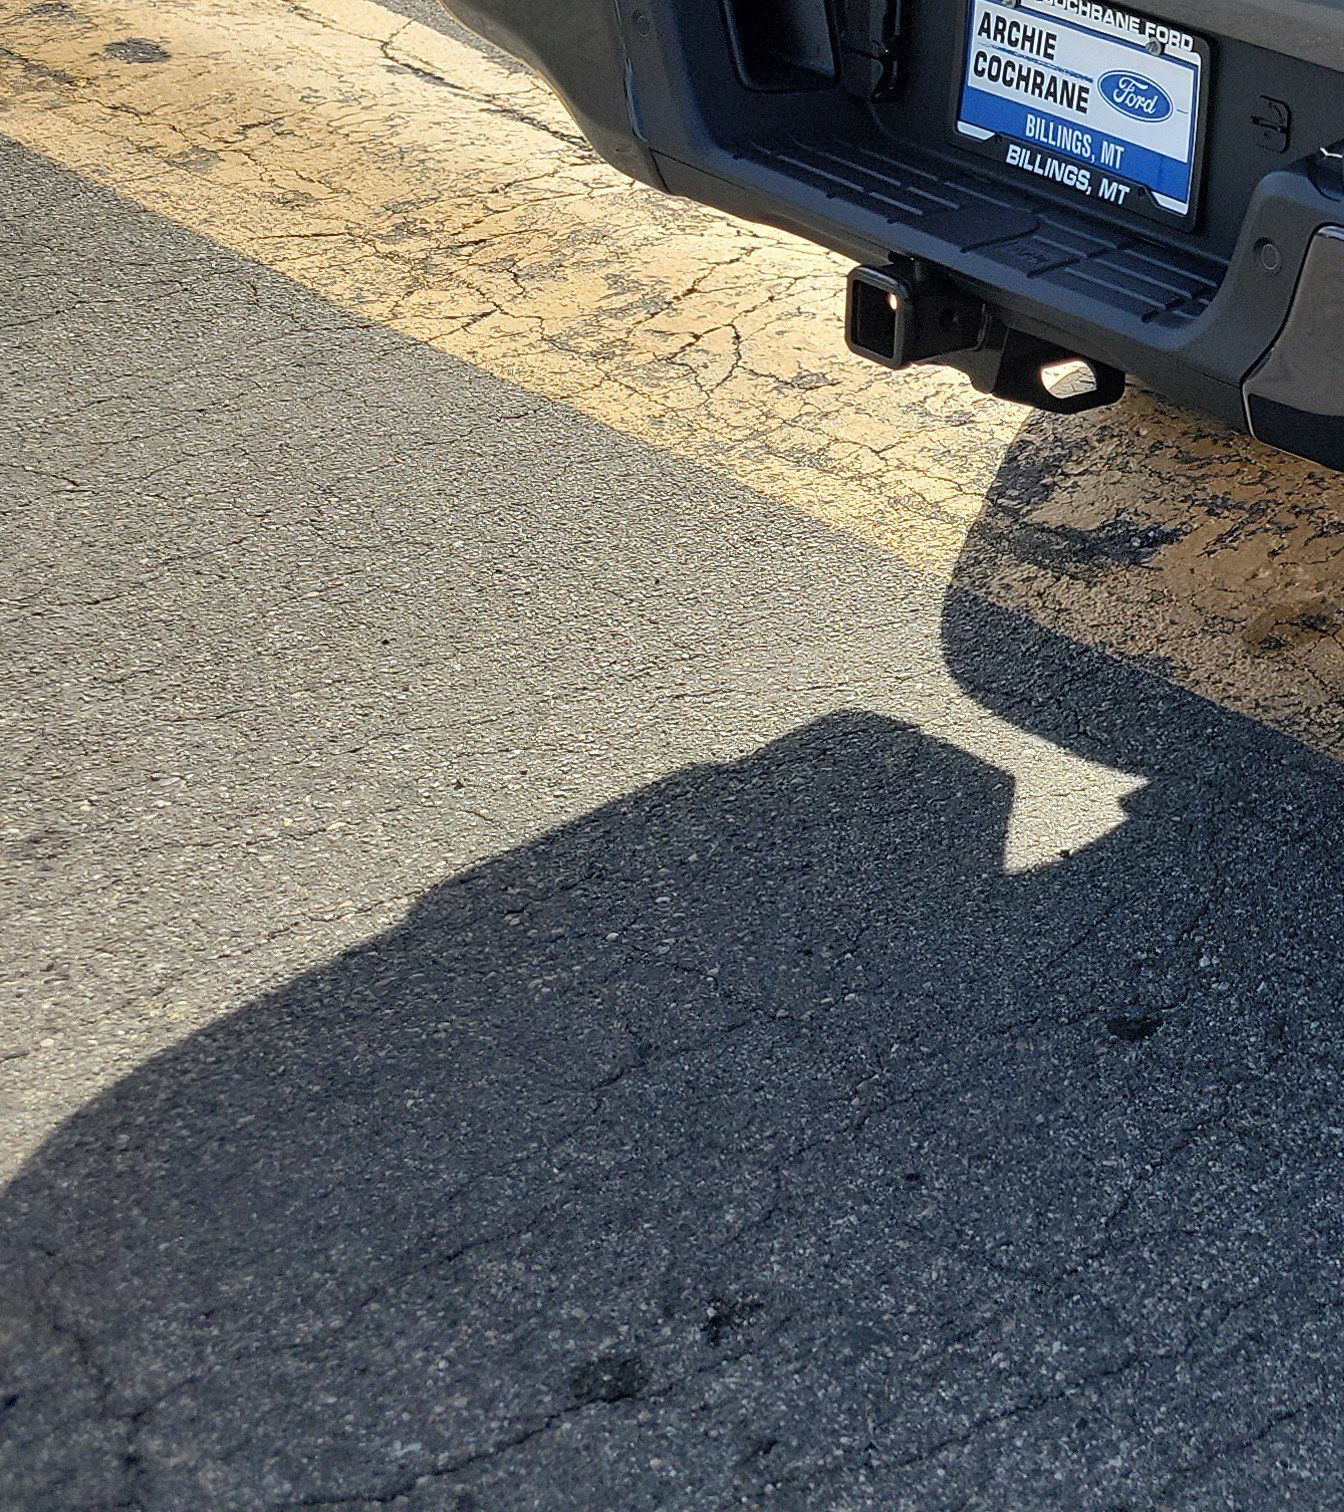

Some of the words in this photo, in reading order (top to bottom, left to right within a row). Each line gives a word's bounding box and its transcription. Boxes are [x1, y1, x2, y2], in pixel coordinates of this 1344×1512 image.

[976, 10, 1058, 62] ARCHIE
[1145, 22, 1195, 53] FORD
[973, 50, 1091, 116] COCHRANE
[1112, 75, 1159, 115] Ford
[1025, 113, 1096, 164] BILLINGS,
[1100, 142, 1125, 170] MT
[1005, 144, 1093, 196] BILLINGS,
[1098, 176, 1131, 206] MT
